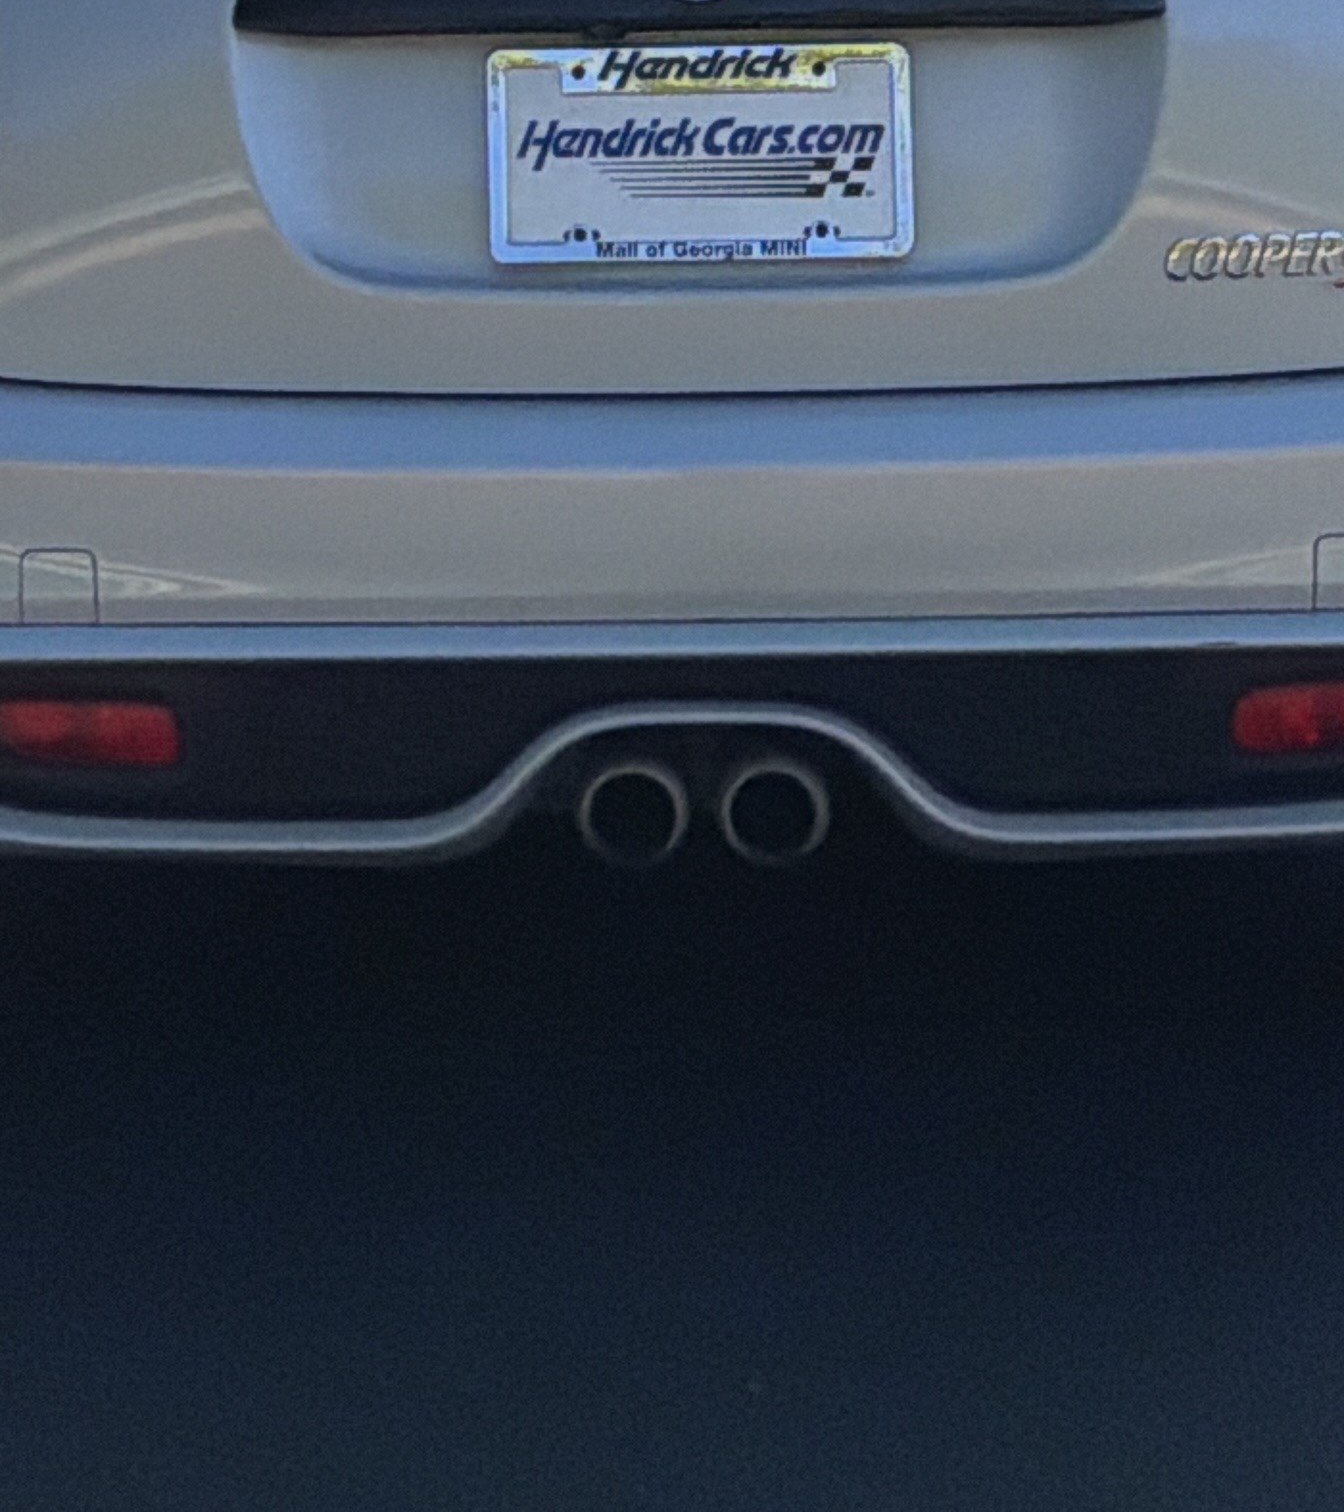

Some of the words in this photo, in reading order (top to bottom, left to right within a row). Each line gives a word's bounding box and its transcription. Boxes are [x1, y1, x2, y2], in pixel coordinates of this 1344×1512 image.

[598, 48, 797, 90] Hendrick
[517, 117, 885, 171] HendrickCars.com
[596, 241, 638, 258] Mall
[645, 241, 665, 258] of
[673, 240, 754, 260] Georgia
[760, 238, 808, 256] MINI
[1165, 230, 1344, 281] COOPER
